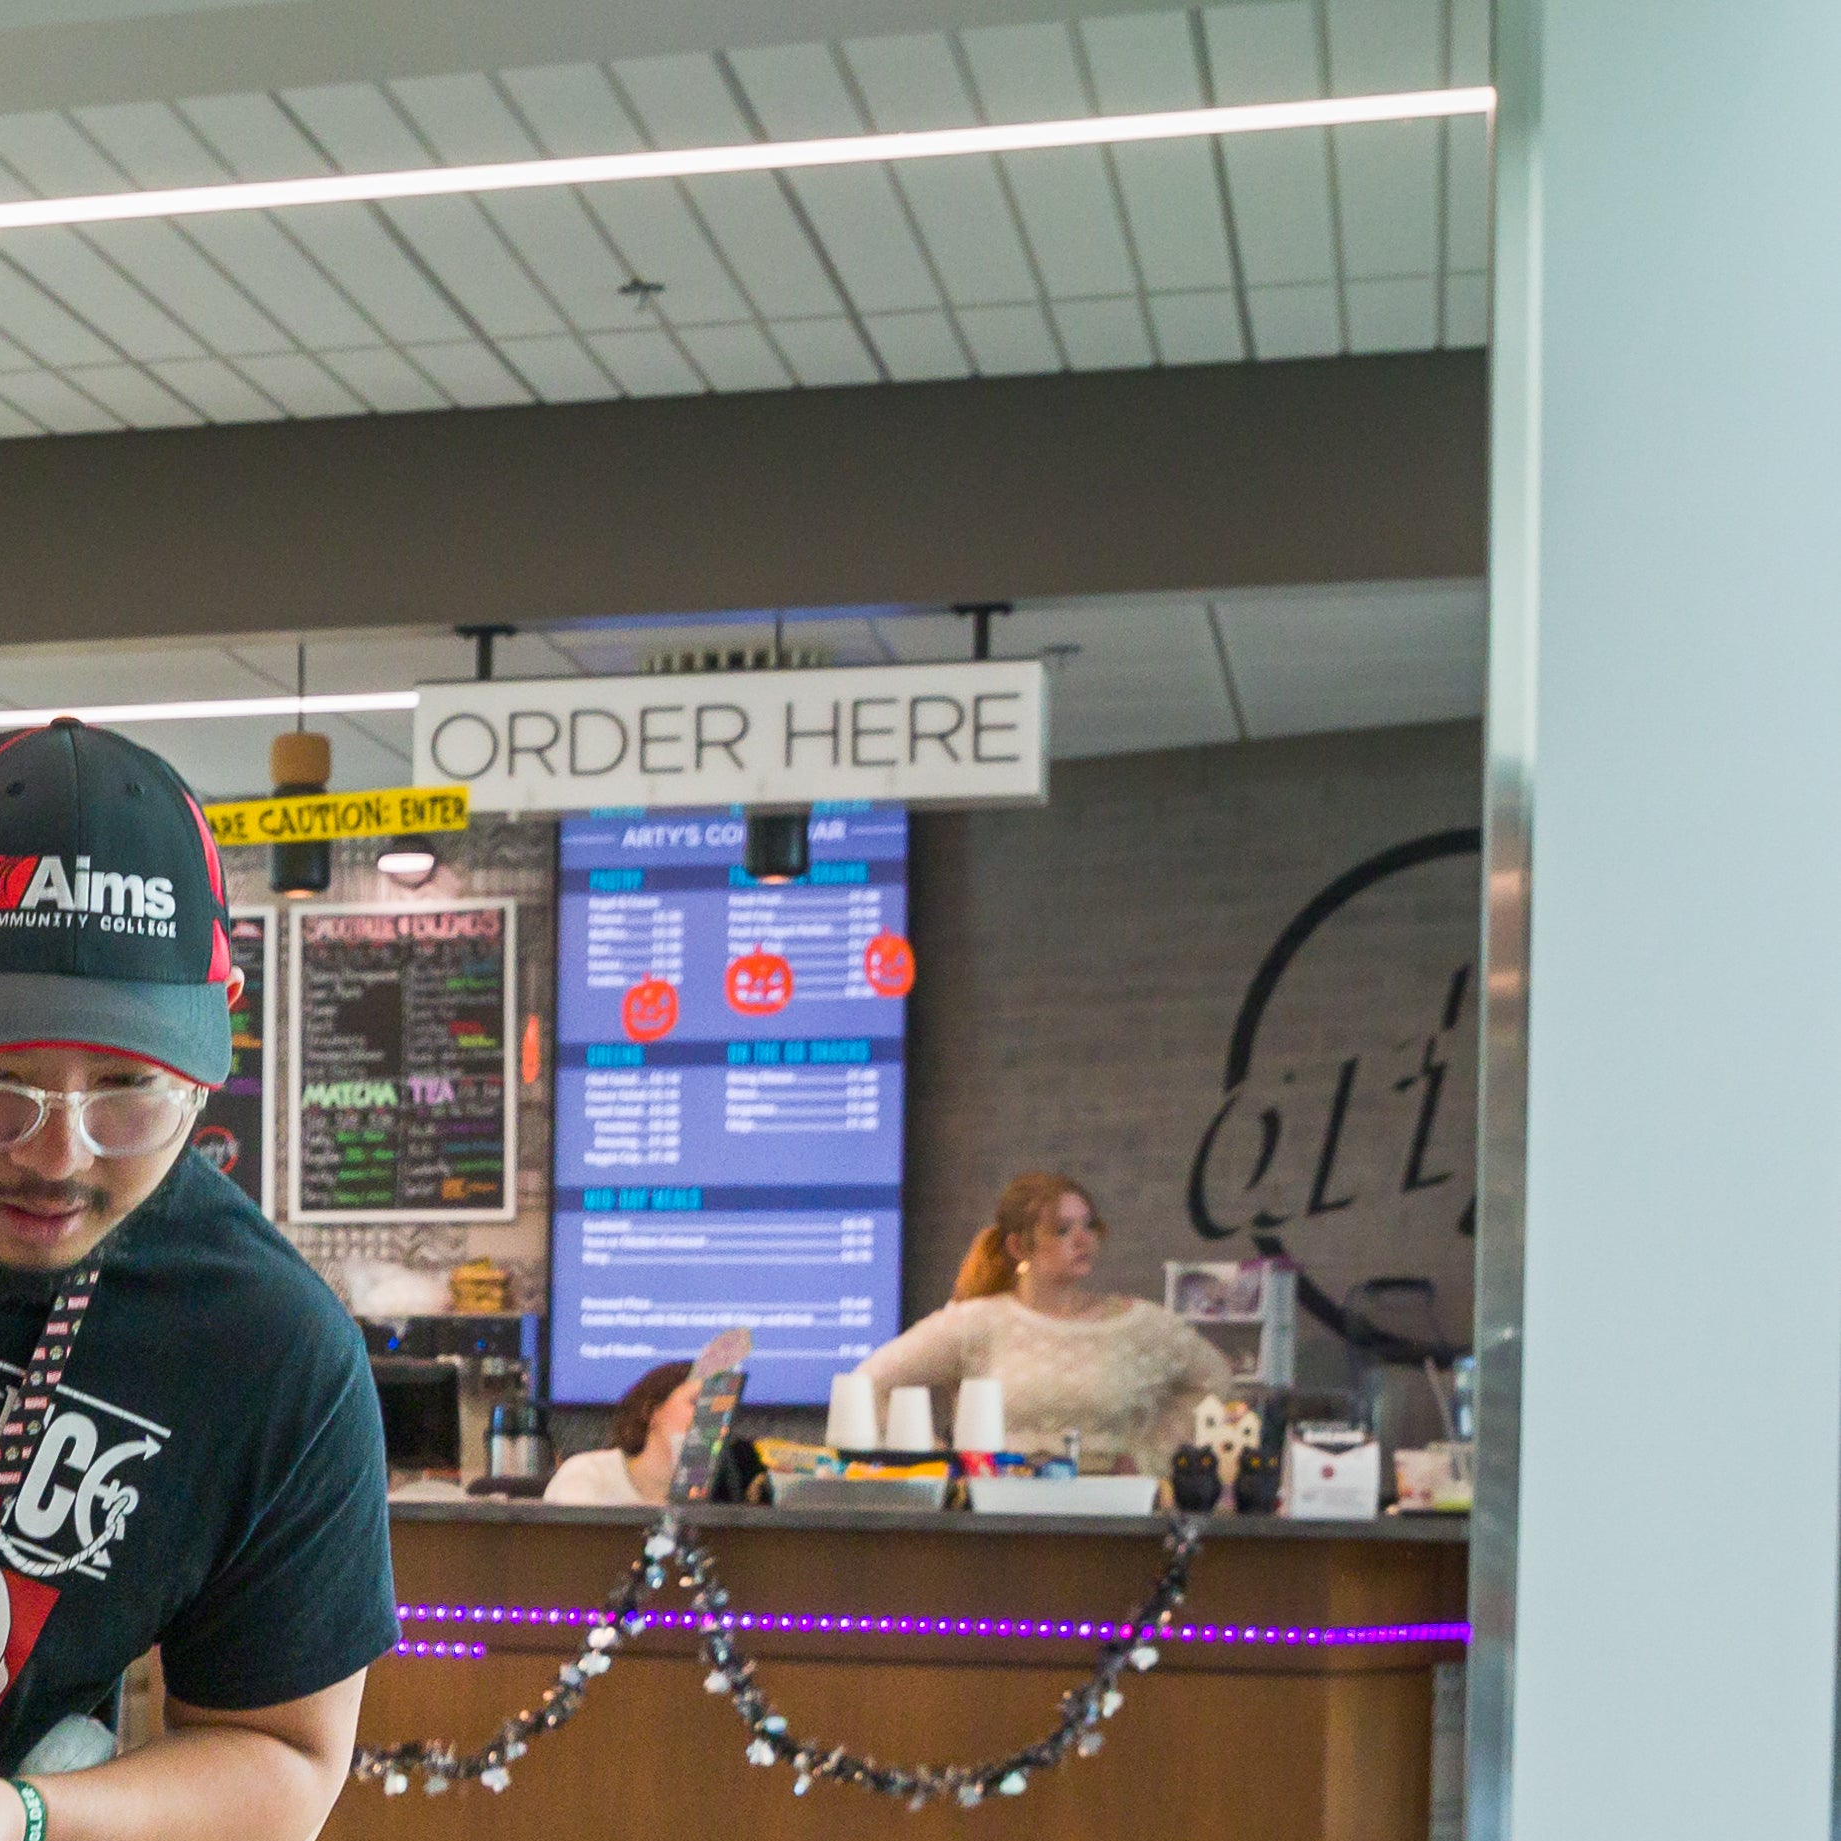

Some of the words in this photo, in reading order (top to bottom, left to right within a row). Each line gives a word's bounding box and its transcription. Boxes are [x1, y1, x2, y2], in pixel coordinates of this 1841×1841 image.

[429, 703, 752, 781] ORDER
[784, 691, 1022, 769] HERE
[258, 797, 390, 837] CAUTION:
[400, 795, 466, 828] ENTER
[621, 823, 701, 850] ARTY'S
[19, 854, 176, 921] Aims
[99, 914, 178, 939] COLLEGE
[301, 1080, 399, 1109] MATCHA
[408, 1075, 456, 1105] TEA
